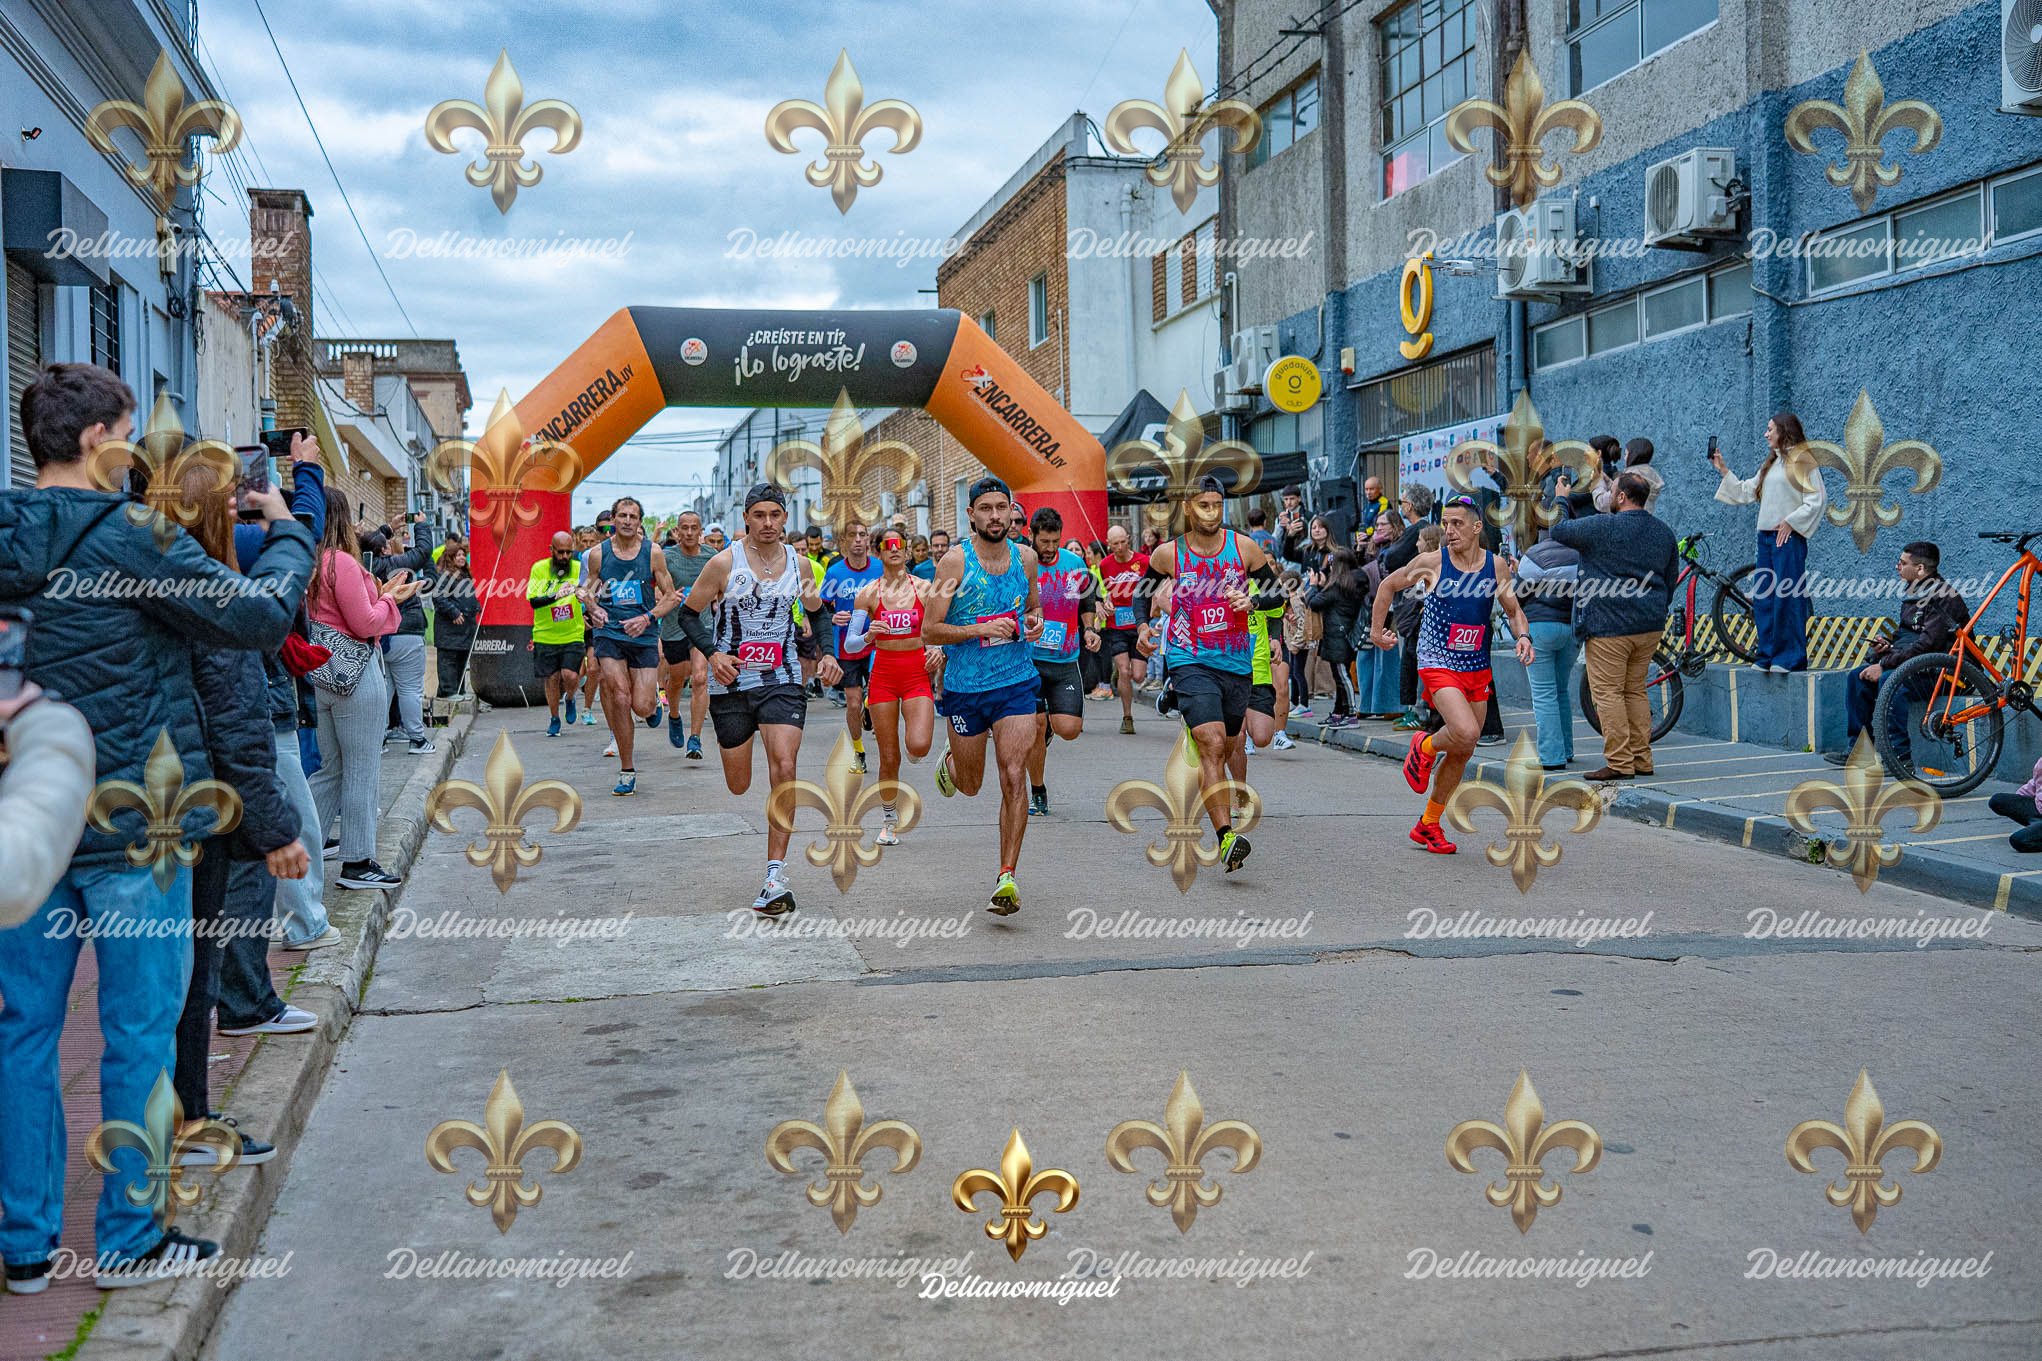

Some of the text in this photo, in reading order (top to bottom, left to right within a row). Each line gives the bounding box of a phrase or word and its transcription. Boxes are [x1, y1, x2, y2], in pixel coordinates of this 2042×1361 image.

[746, 328, 847, 347] ¿CREÍSTE EN TÍ?
[773, 342, 866, 382] lograste!
[1275, 361, 1316, 380] guadalupe
[554, 606, 571, 618] 245
[887, 612, 911, 628] 178
[1201, 606, 1225, 625] 199
[1041, 629, 1062, 643] 425
[1454, 628, 1479, 644] 207
[744, 645, 776, 663] 234
[954, 723, 969, 734] CK
